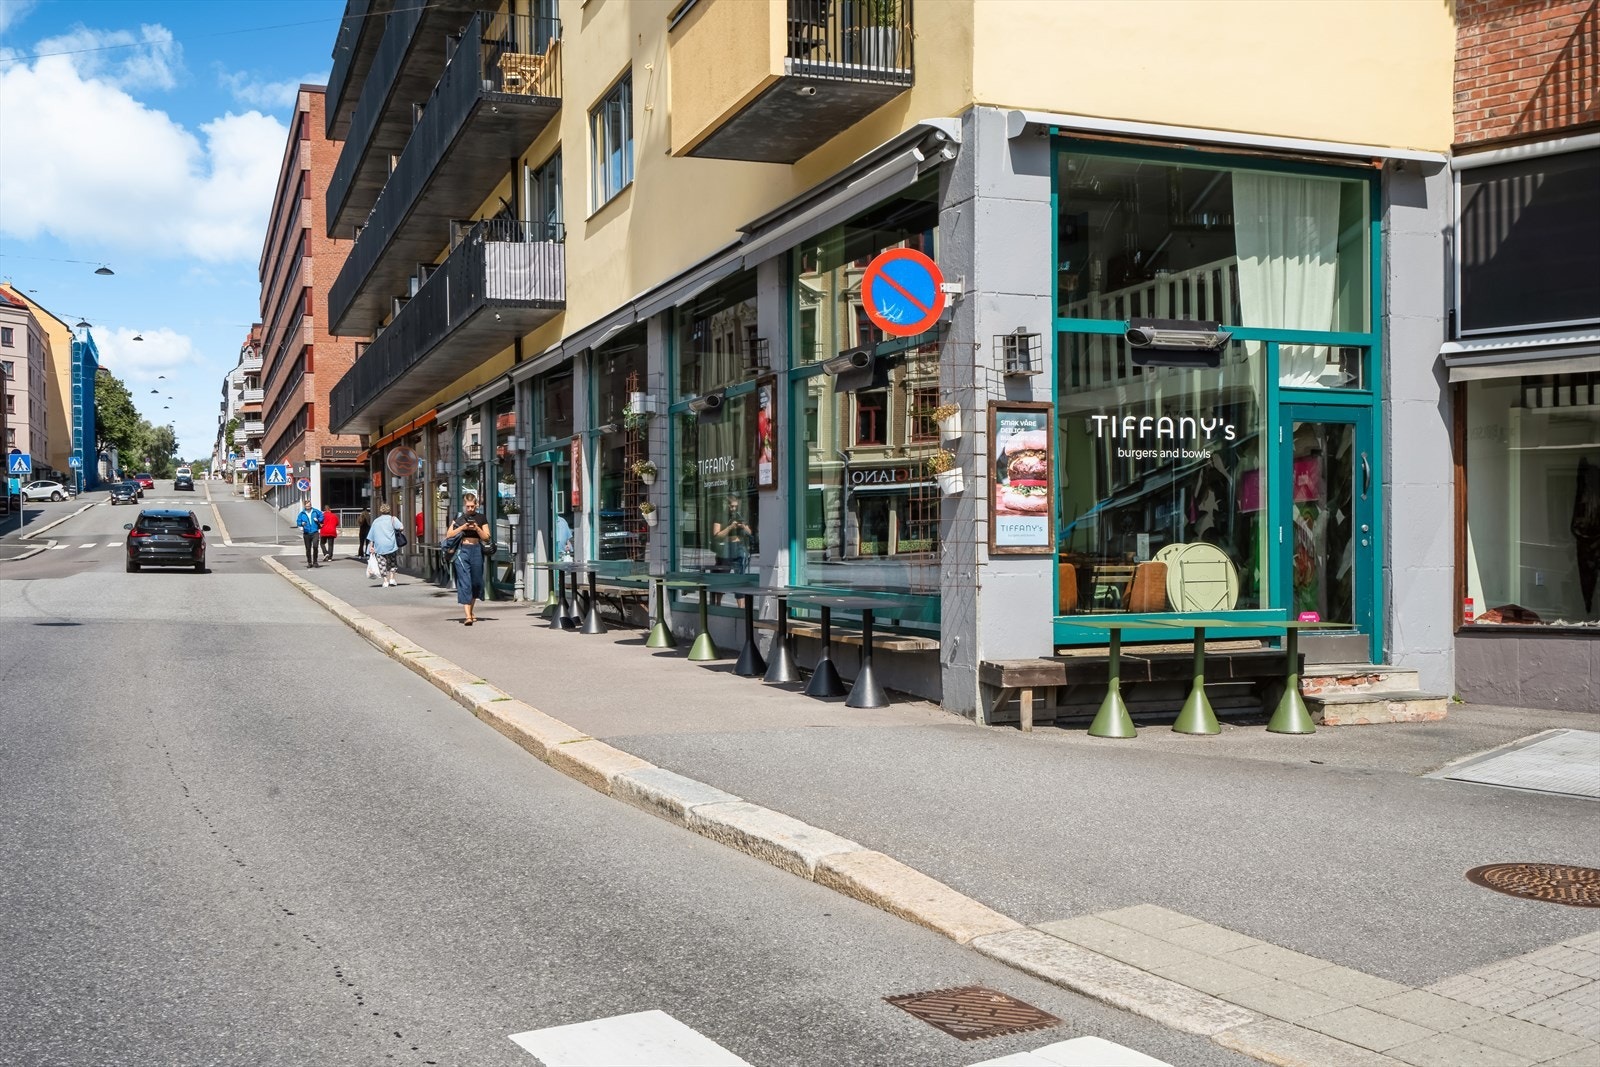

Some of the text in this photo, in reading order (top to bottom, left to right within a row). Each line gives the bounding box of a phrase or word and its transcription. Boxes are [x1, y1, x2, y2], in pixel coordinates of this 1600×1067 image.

[1091, 414, 1236, 441] TIFFANY's
[1118, 446, 1211, 460] burgers and bowls
[697, 455, 735, 475] TIFFANY's
[1000, 524, 1043, 532] TIFFANY's
